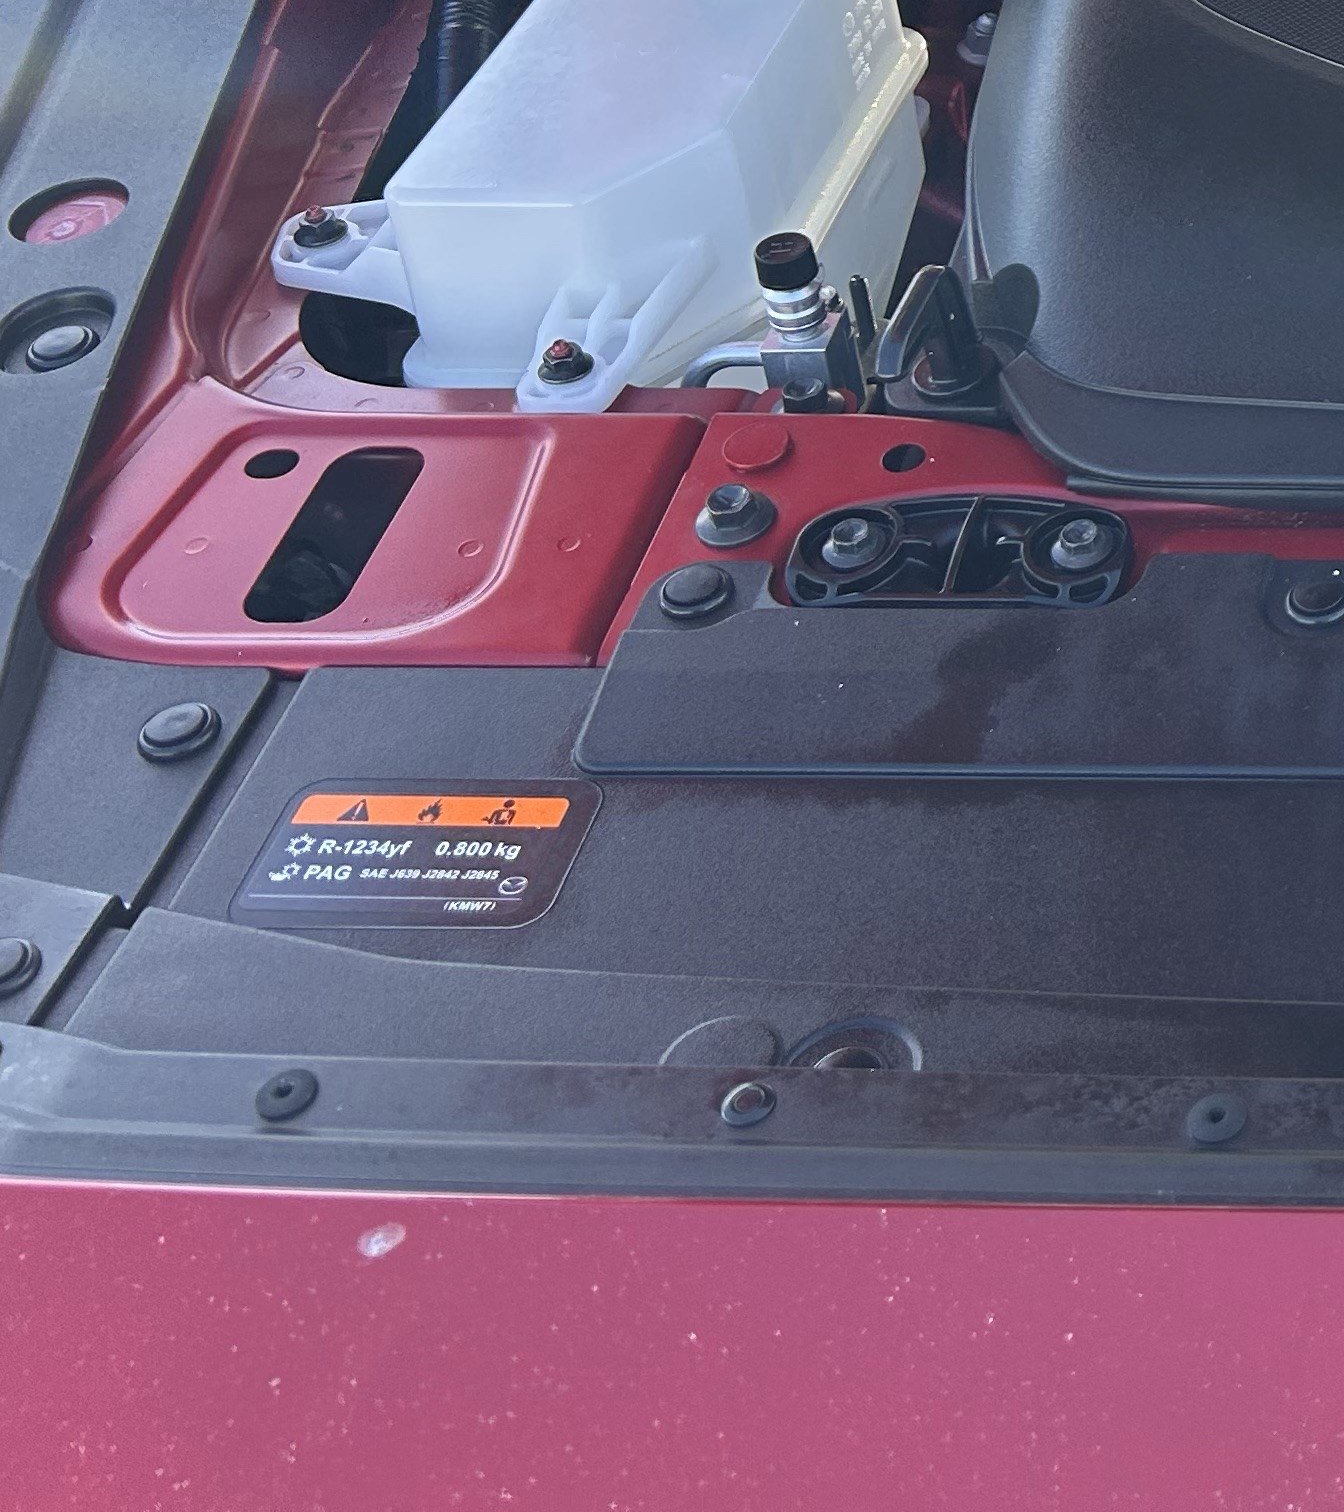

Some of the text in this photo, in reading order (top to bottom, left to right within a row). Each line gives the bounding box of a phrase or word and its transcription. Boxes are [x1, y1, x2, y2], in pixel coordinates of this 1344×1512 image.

[317, 839, 522, 860] R-1234yf 0.800 kg
[303, 864, 353, 881] PAG
[359, 868, 389, 879] SAE
[442, 900, 497, 912] (KMW7)
